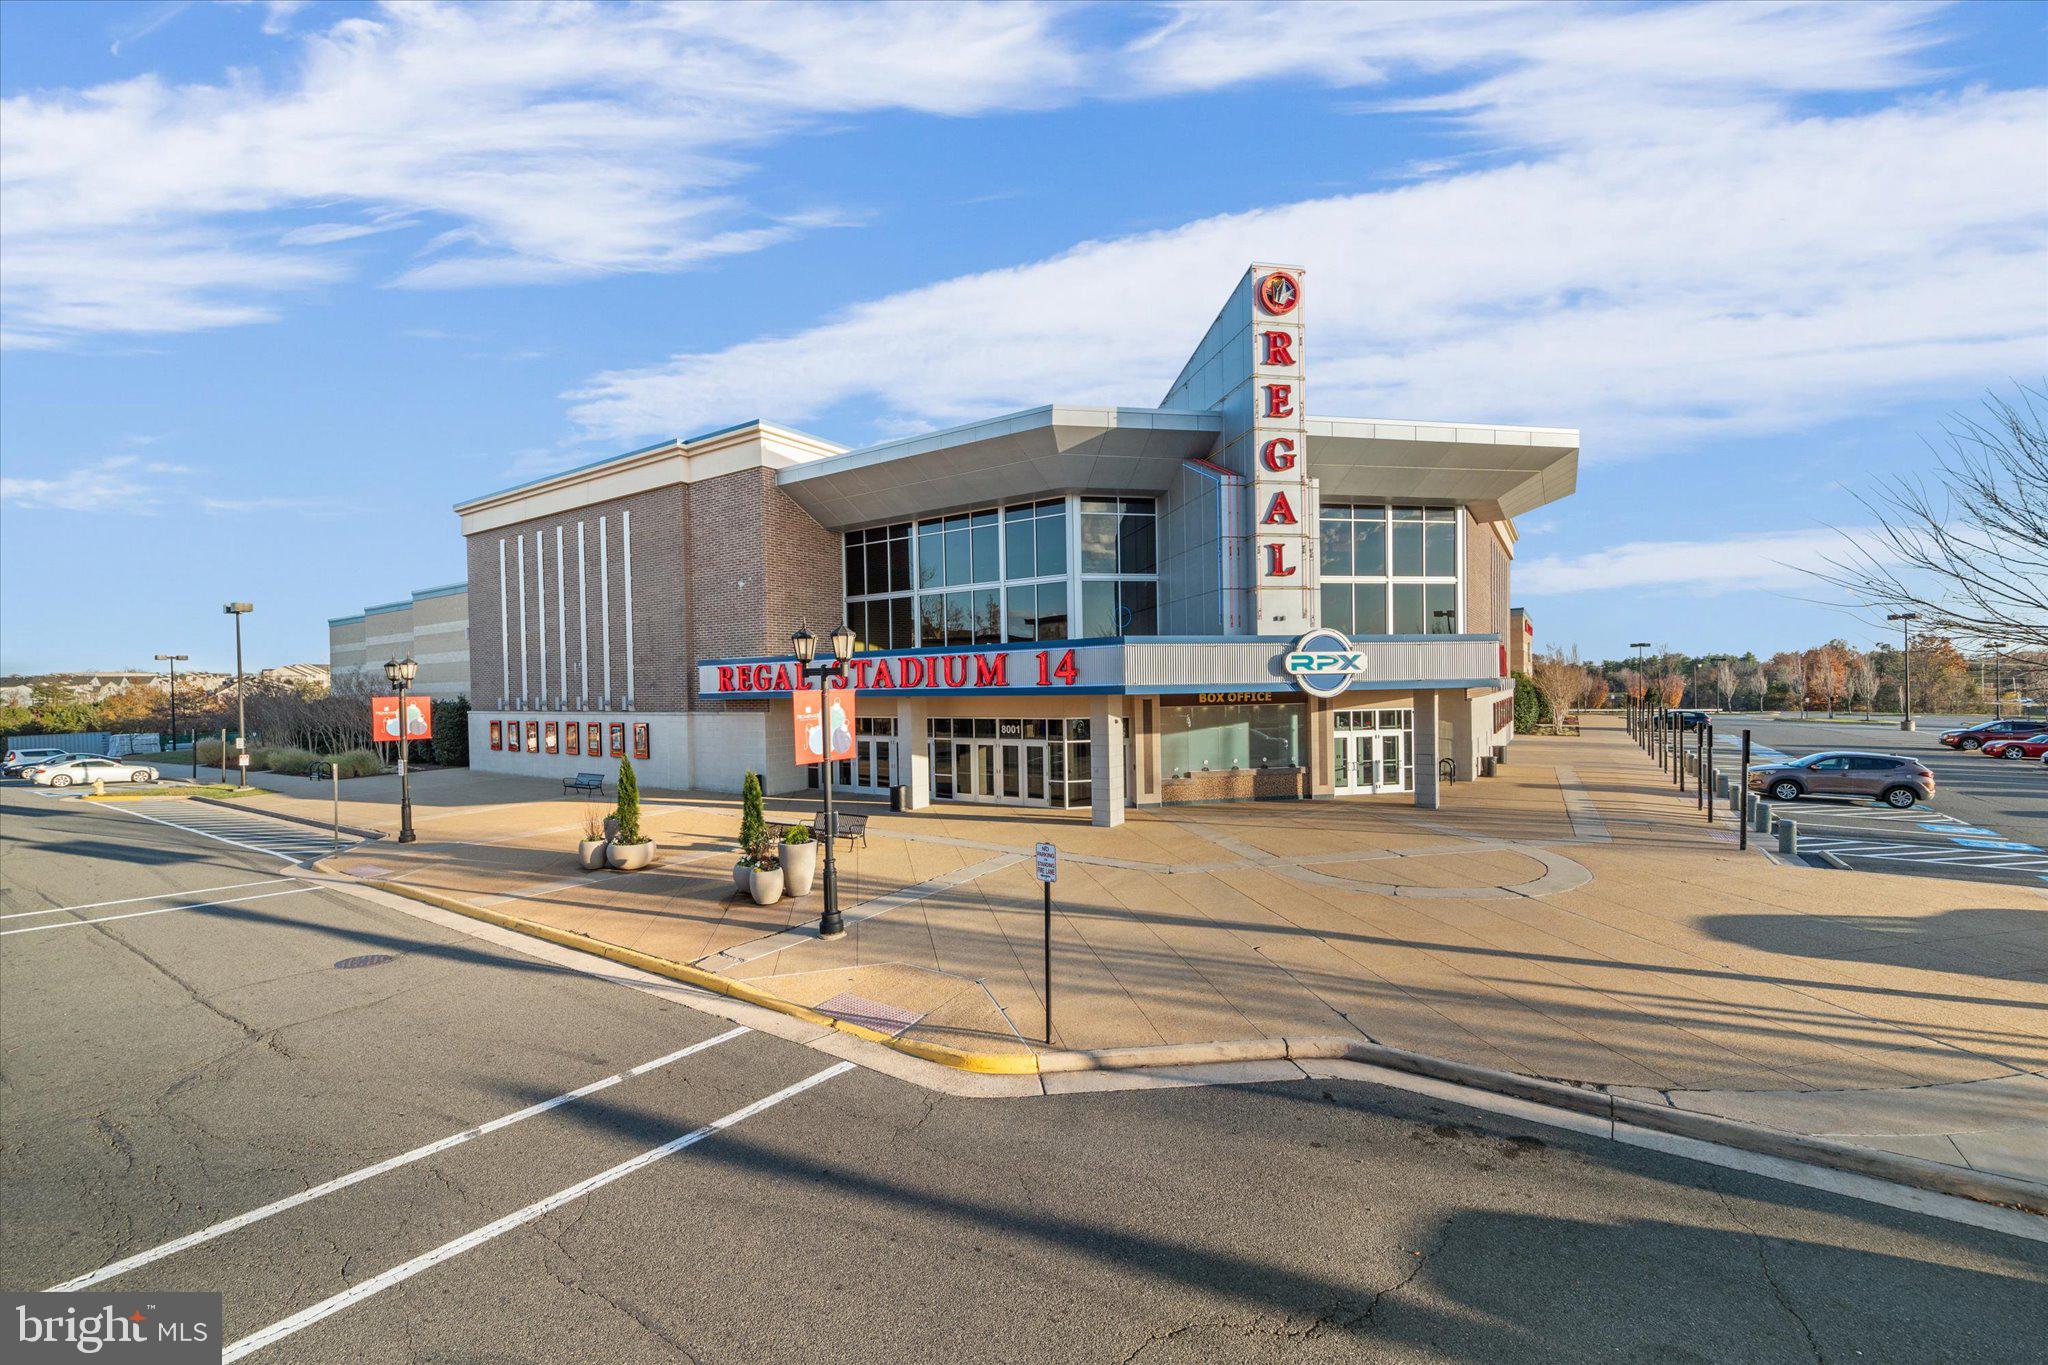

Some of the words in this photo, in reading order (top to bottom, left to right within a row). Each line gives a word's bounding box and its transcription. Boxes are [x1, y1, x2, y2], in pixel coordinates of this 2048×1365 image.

[1264, 330, 1298, 577] REGAL
[1291, 654, 1361, 671] RPX
[717, 662, 813, 692] REGAL
[832, 653, 1010, 689] STADIUM
[1035, 649, 1080, 686] 14
[1199, 693, 1225, 703] BOX
[1228, 691, 1272, 702] OFFICE
[1000, 724, 1021, 734] 8001
[1037, 851, 1055, 859] PARKING
